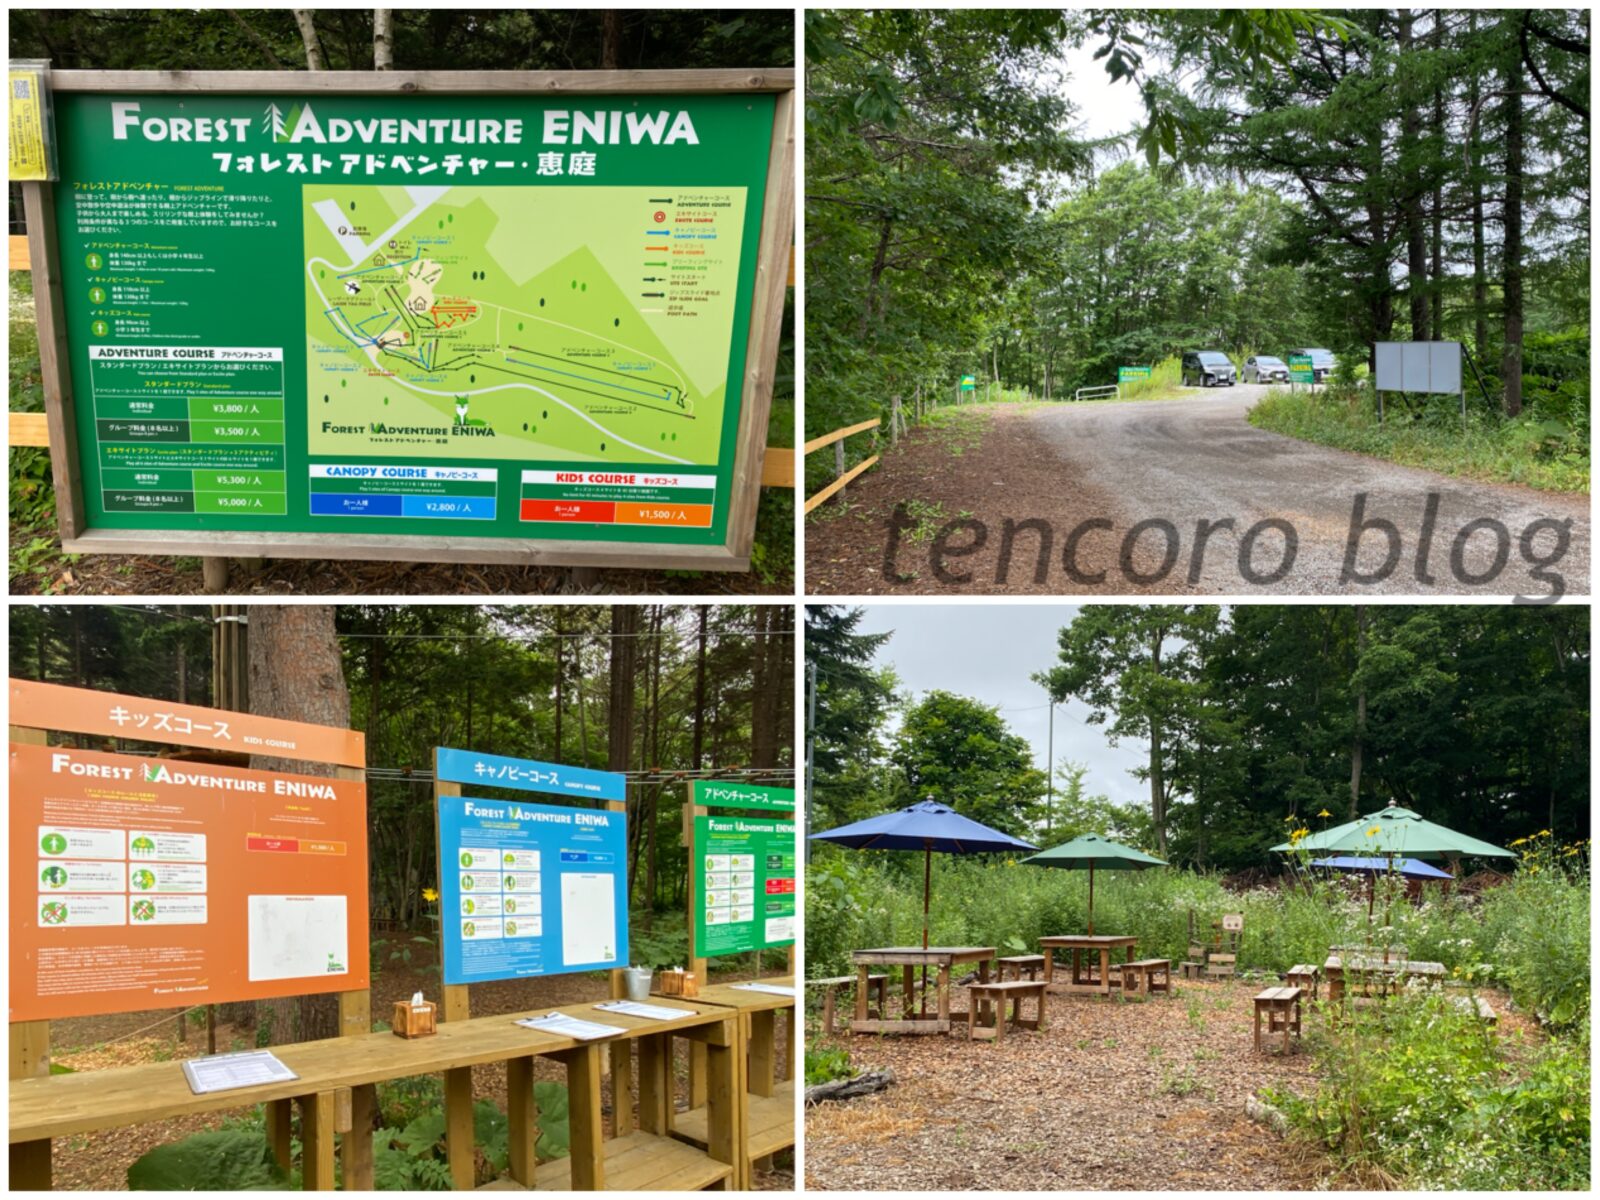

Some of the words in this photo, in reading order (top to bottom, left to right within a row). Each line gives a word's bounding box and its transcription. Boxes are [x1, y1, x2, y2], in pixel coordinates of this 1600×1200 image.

[111, 102, 251, 142] FOREST
[290, 102, 522, 144] ADVENTURE
[542, 110, 700, 144] ENIWA
[98, 348, 169, 358] ADVENTURE
[172, 349, 215, 358] COURSE
[221, 351, 273, 359] アドベンチャーコース
[213, 404, 243, 413] ¥3,800
[250, 404, 259, 413] 人
[214, 427, 243, 435] ¥3,500
[251, 426, 260, 435] 人
[322, 422, 365, 433] FOREST
[378, 423, 448, 435] ADVENTURE
[452, 427, 495, 437] ENIWA
[326, 467, 377, 477] CANOPY
[382, 467, 427, 478] COURSE
[217, 476, 246, 485] ¥5,300
[253, 476, 262, 485] 人
[556, 473, 584, 483] KIDS
[588, 474, 635, 484] COURSE
[218, 498, 247, 507] ¥5,000
[254, 498, 263, 507] 人
[426, 503, 456, 512] ¥2,800
[463, 504, 472, 513] 人
[640, 510, 670, 519] ¥1,500
[678, 511, 687, 520] 人
[109, 706, 232, 740] キッズコース
[243, 735, 263, 744] KIDS
[265, 738, 296, 749] COURSE
[52, 754, 132, 779] FOREST
[153, 763, 266, 793] ADVENTURE
[274, 780, 337, 800] ENIWA
[474, 761, 559, 785] キャノピーコース
[705, 787, 769, 804] アドベンチャーコース
[464, 802, 504, 818] FOREST
[515, 806, 571, 823] ADVENTURE
[575, 812, 609, 827] ENIWA
[708, 819, 733, 831] FOREST
